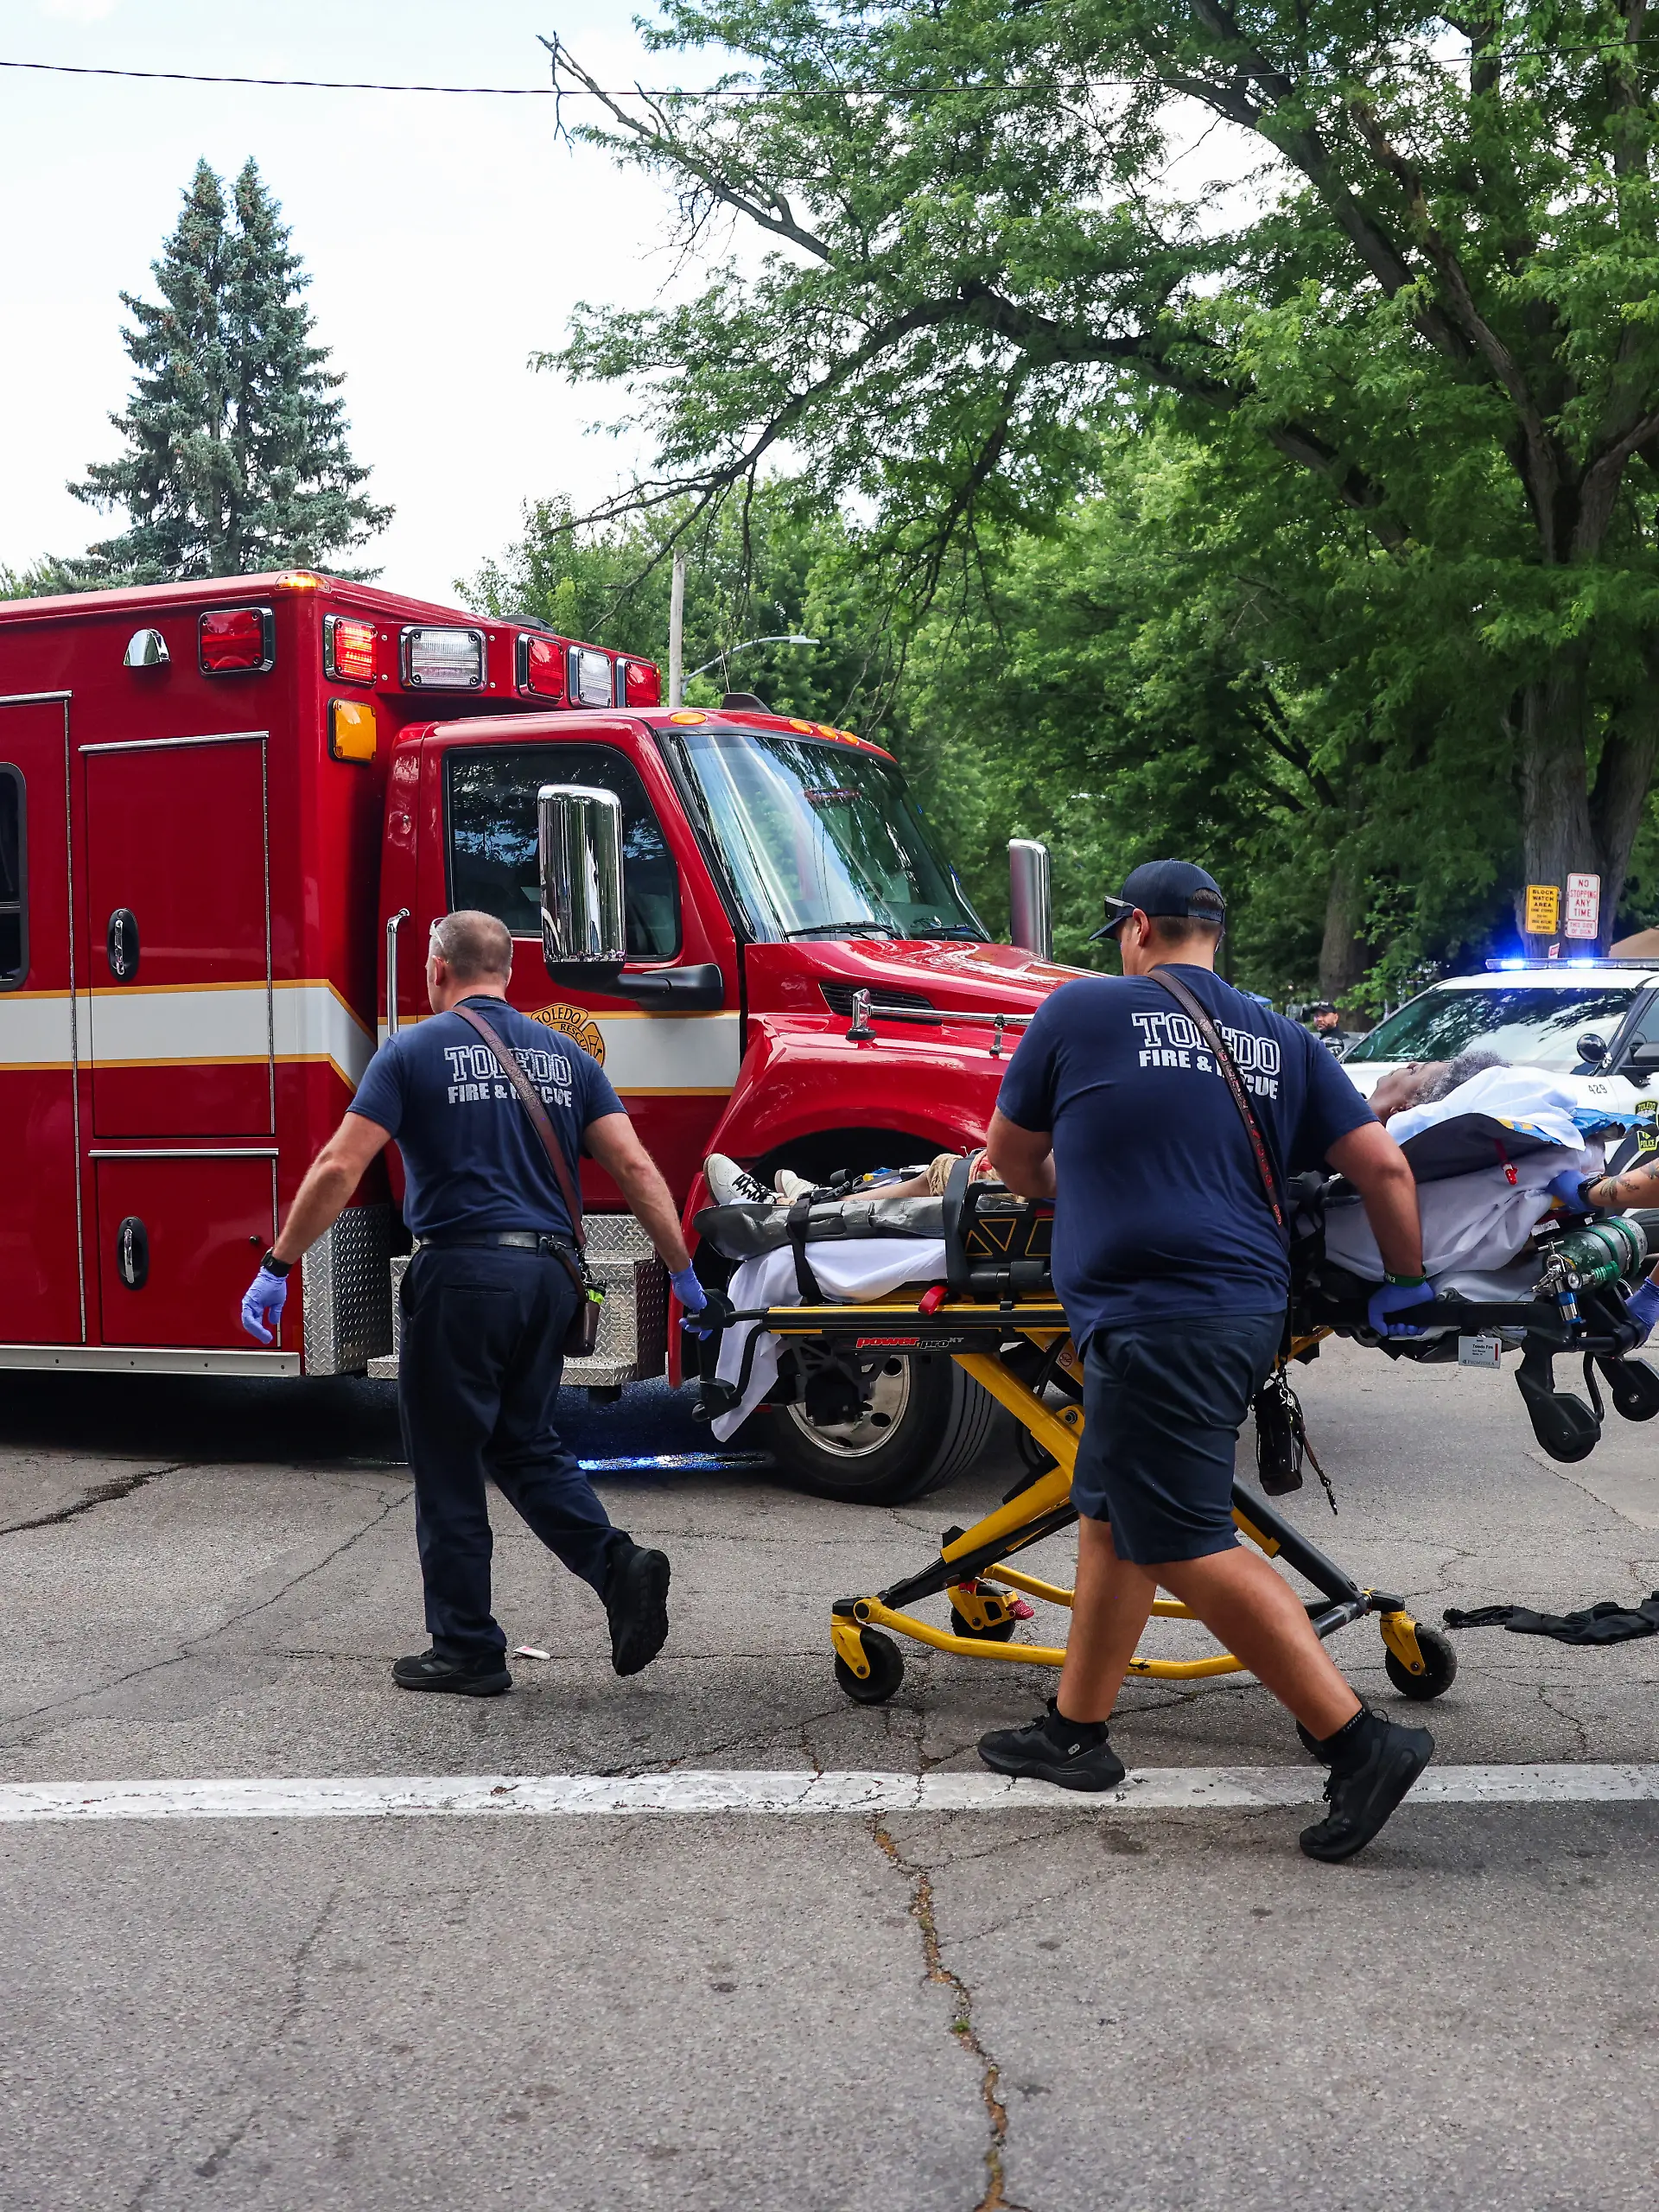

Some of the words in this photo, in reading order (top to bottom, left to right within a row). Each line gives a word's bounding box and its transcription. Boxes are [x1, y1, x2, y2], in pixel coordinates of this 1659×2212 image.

[1570, 890, 1597, 899] STOPPING
[535, 1007, 581, 1025] TOLEDO
[1139, 1049, 1192, 1069] FIRE
[1196, 1056, 1212, 1073] &
[448, 1083, 491, 1104] FIRE
[494, 1084, 508, 1099] &
[1587, 1084, 1607, 1094] 429
[855, 1338, 919, 1348] power
